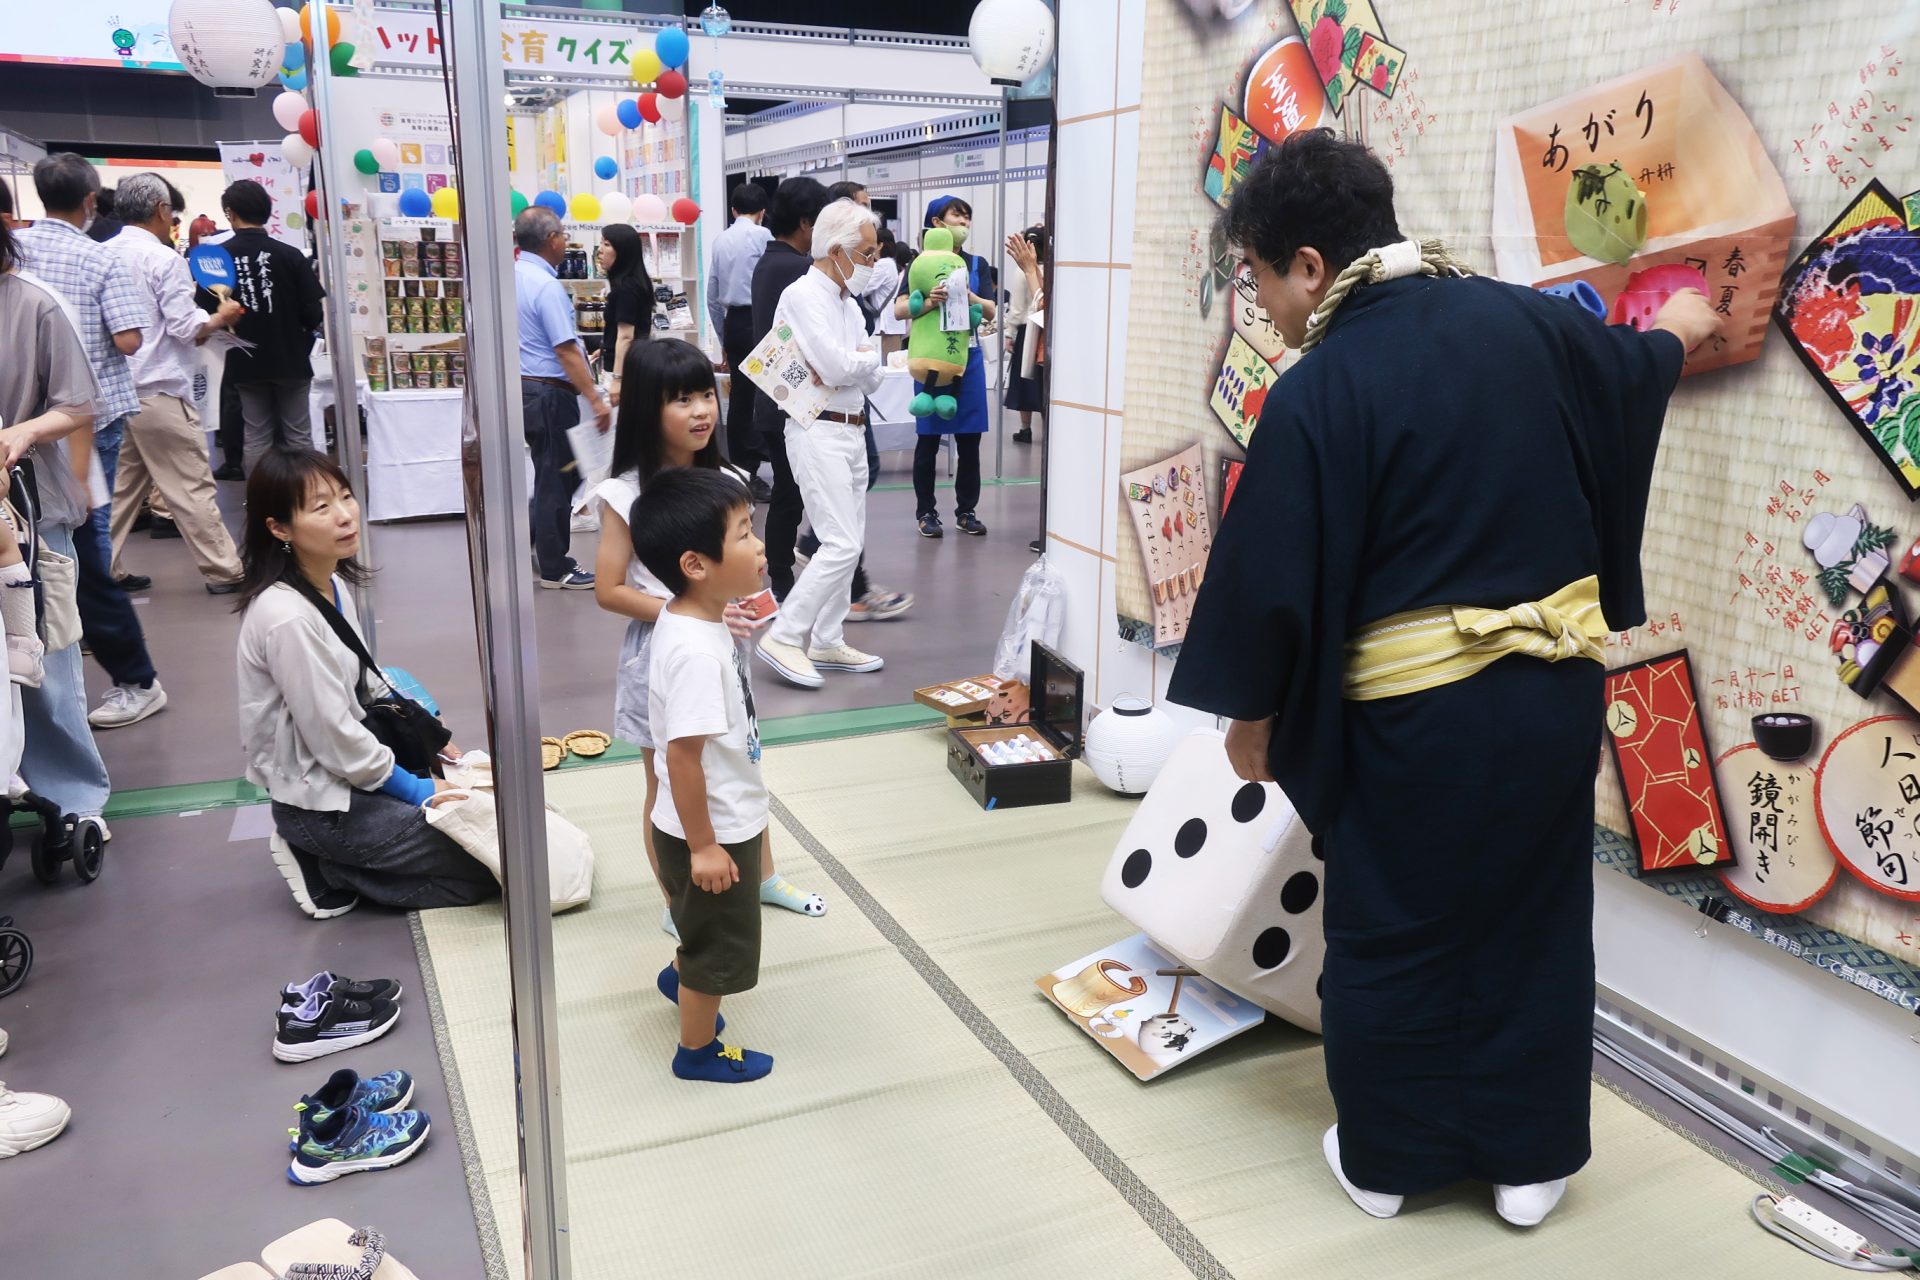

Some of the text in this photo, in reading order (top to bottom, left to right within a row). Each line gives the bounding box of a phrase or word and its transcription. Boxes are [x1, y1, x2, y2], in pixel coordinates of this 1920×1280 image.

[247, 47, 266, 79] 研究所
[1261, 63, 1308, 132] 夏至
[1542, 88, 1654, 174] あがり
[1792, 101, 1840, 155] 十二月
[1838, 116, 1914, 191] おしまい
[1631, 161, 1677, 185] 升枡
[1729, 469, 1832, 605] 一月一日 お正月
[1735, 480, 1795, 565] 一月 睦月
[1756, 564, 1784, 600] お節
[1765, 568, 1810, 620] お雑煮
[1648, 612, 1683, 638] 如月
[1782, 592, 1817, 633] 鏡餅
[1804, 609, 1830, 642] GET
[1711, 664, 1795, 689] 一月十一日
[1717, 686, 1801, 710] お汁粉 GET
[1747, 770, 1785, 884] 鏡開き
[1787, 773, 1801, 868] かがみびら
[1855, 806, 1909, 886] 節句
[1726, 910, 1753, 933] 売品
